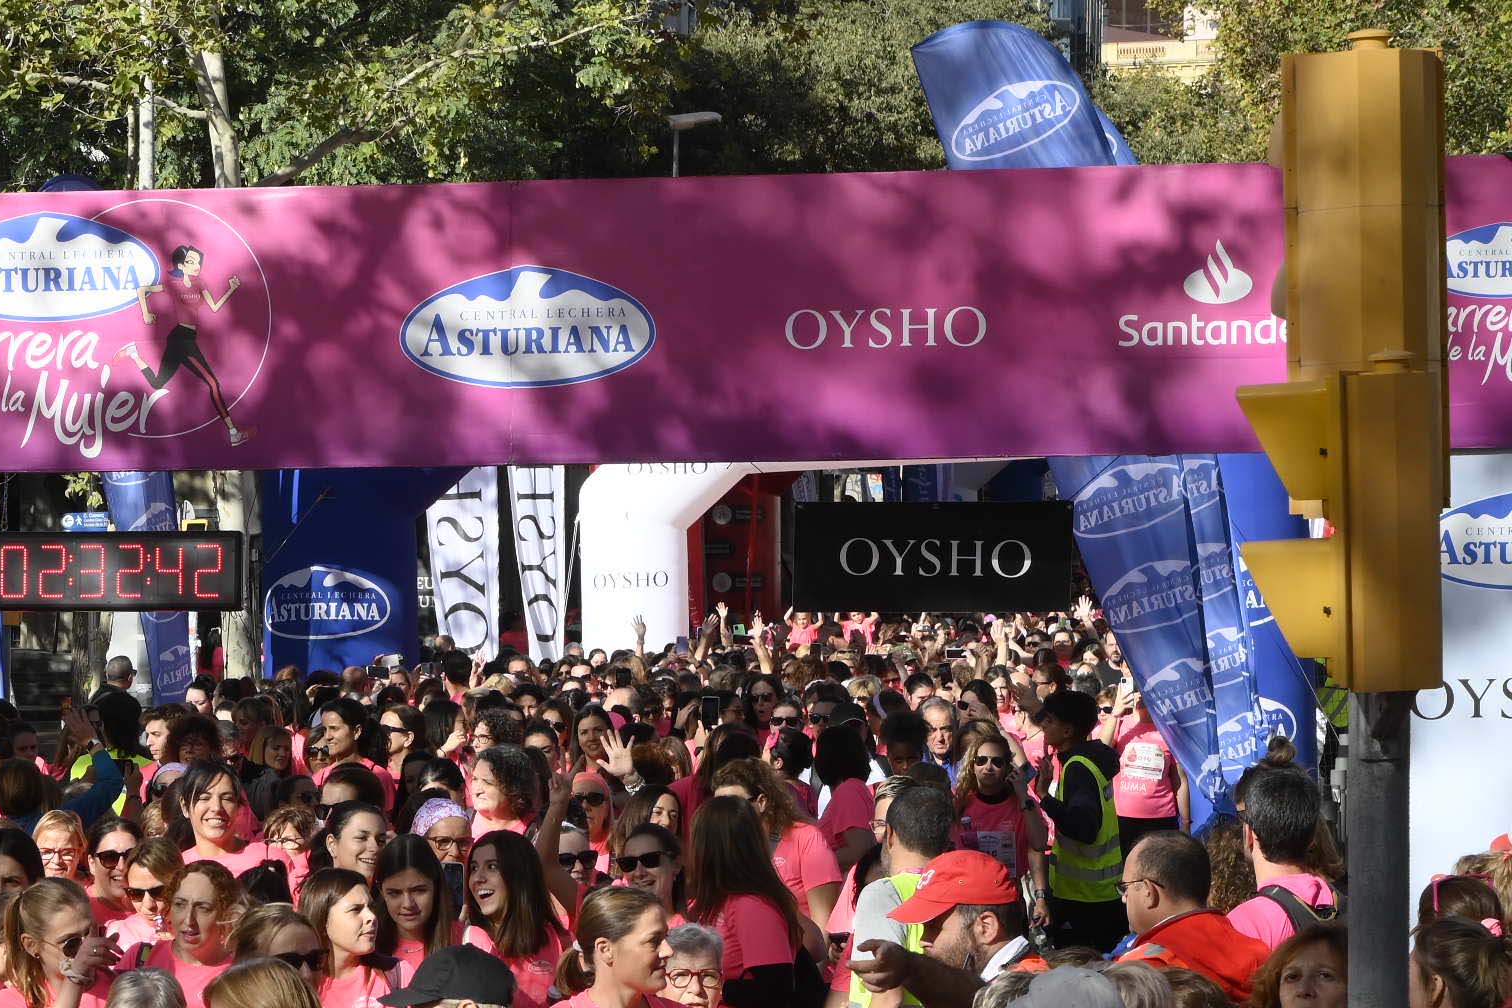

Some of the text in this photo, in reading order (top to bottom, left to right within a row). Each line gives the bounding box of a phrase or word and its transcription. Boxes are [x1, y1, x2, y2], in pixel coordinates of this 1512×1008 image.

[63, 247, 137, 260] LECHERA
[460, 306, 627, 321] CENTRAL LECHERA
[784, 305, 988, 350] OYSHO
[420, 313, 637, 358] ASTURIANA
[1468, 335, 1486, 361] la
[0, 369, 27, 413] la
[20, 363, 171, 459] Mujer
[0, 543, 223, 599] 02:32:42
[839, 537, 1032, 579] OYSHO
[592, 569, 670, 590] OYSHO
[268, 596, 382, 624] ASTURIANA
[1120, 781, 1147, 793] SUMA
